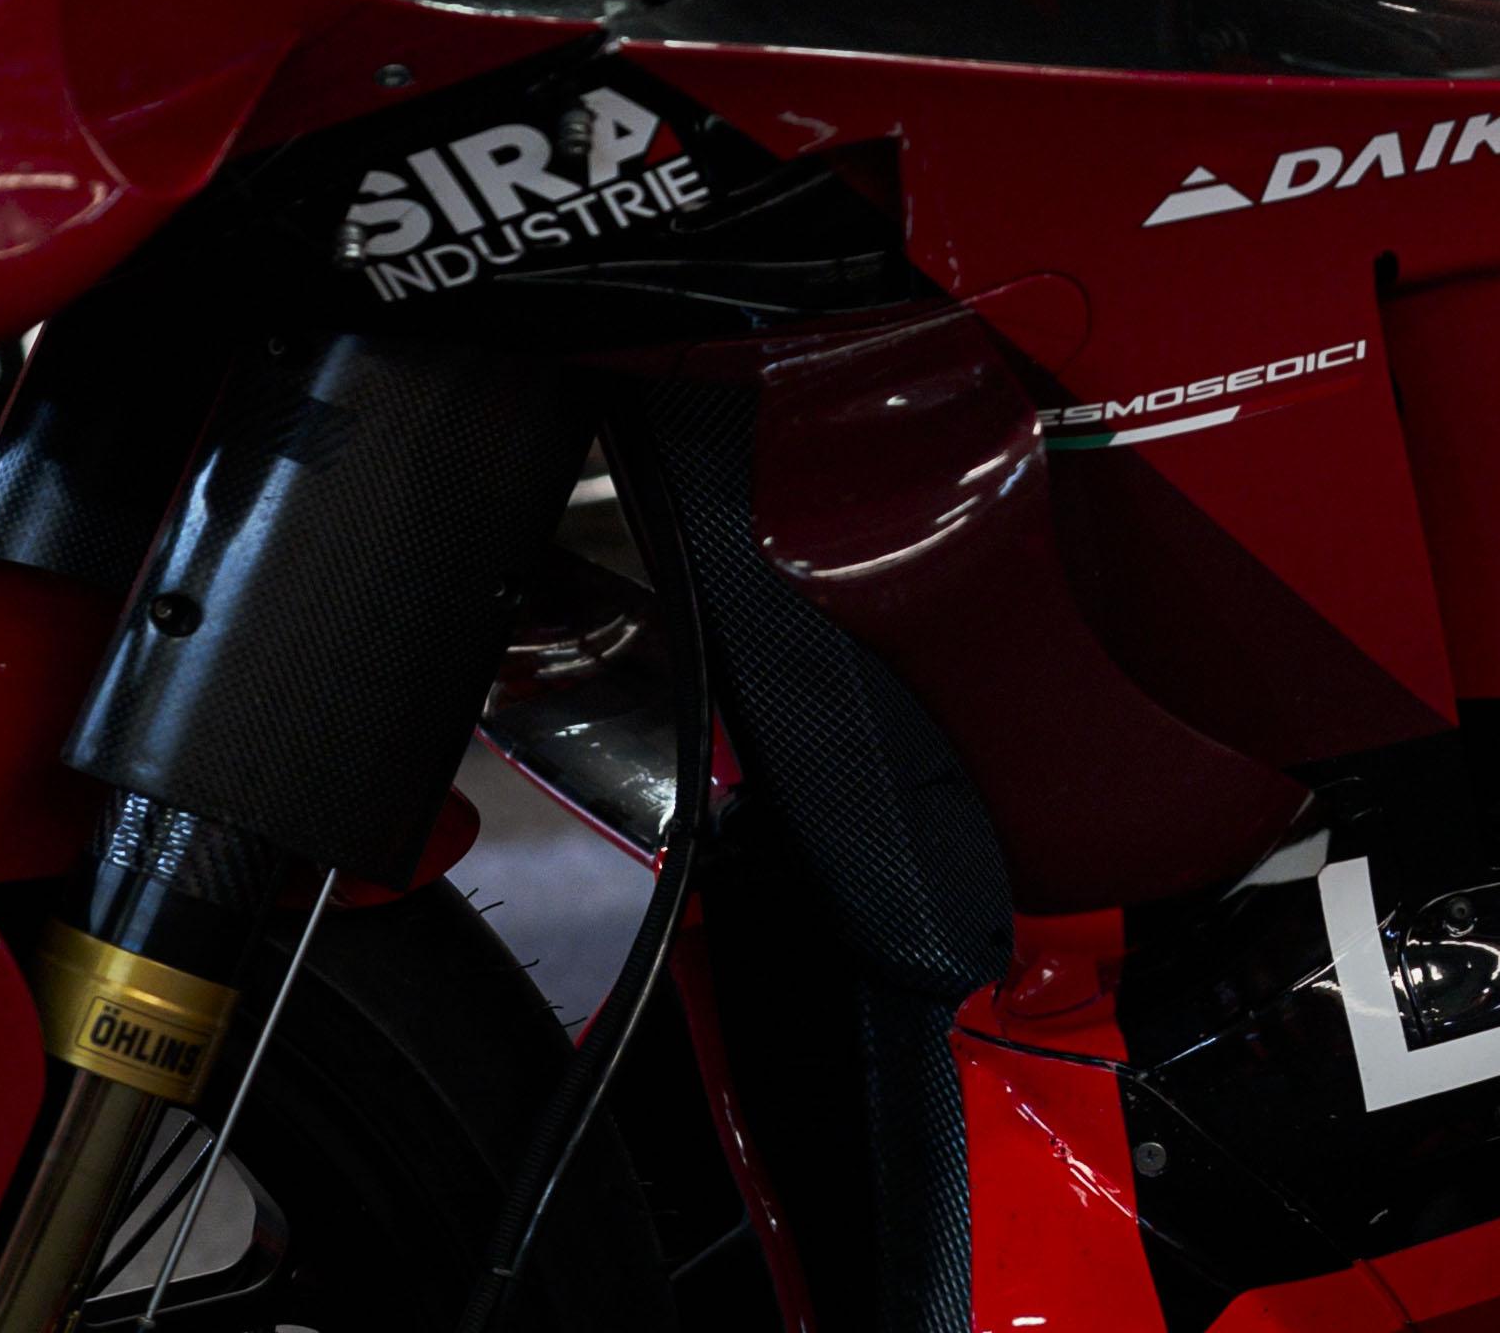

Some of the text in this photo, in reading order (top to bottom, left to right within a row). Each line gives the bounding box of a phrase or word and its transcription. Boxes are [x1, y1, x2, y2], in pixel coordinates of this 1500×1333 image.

[345, 87, 662, 257] SIRA
[364, 155, 711, 303] INDUSTRIE
[1038, 339, 1367, 426] ESMOSEDICI
[89, 1008, 203, 1078] ÖHLINS
